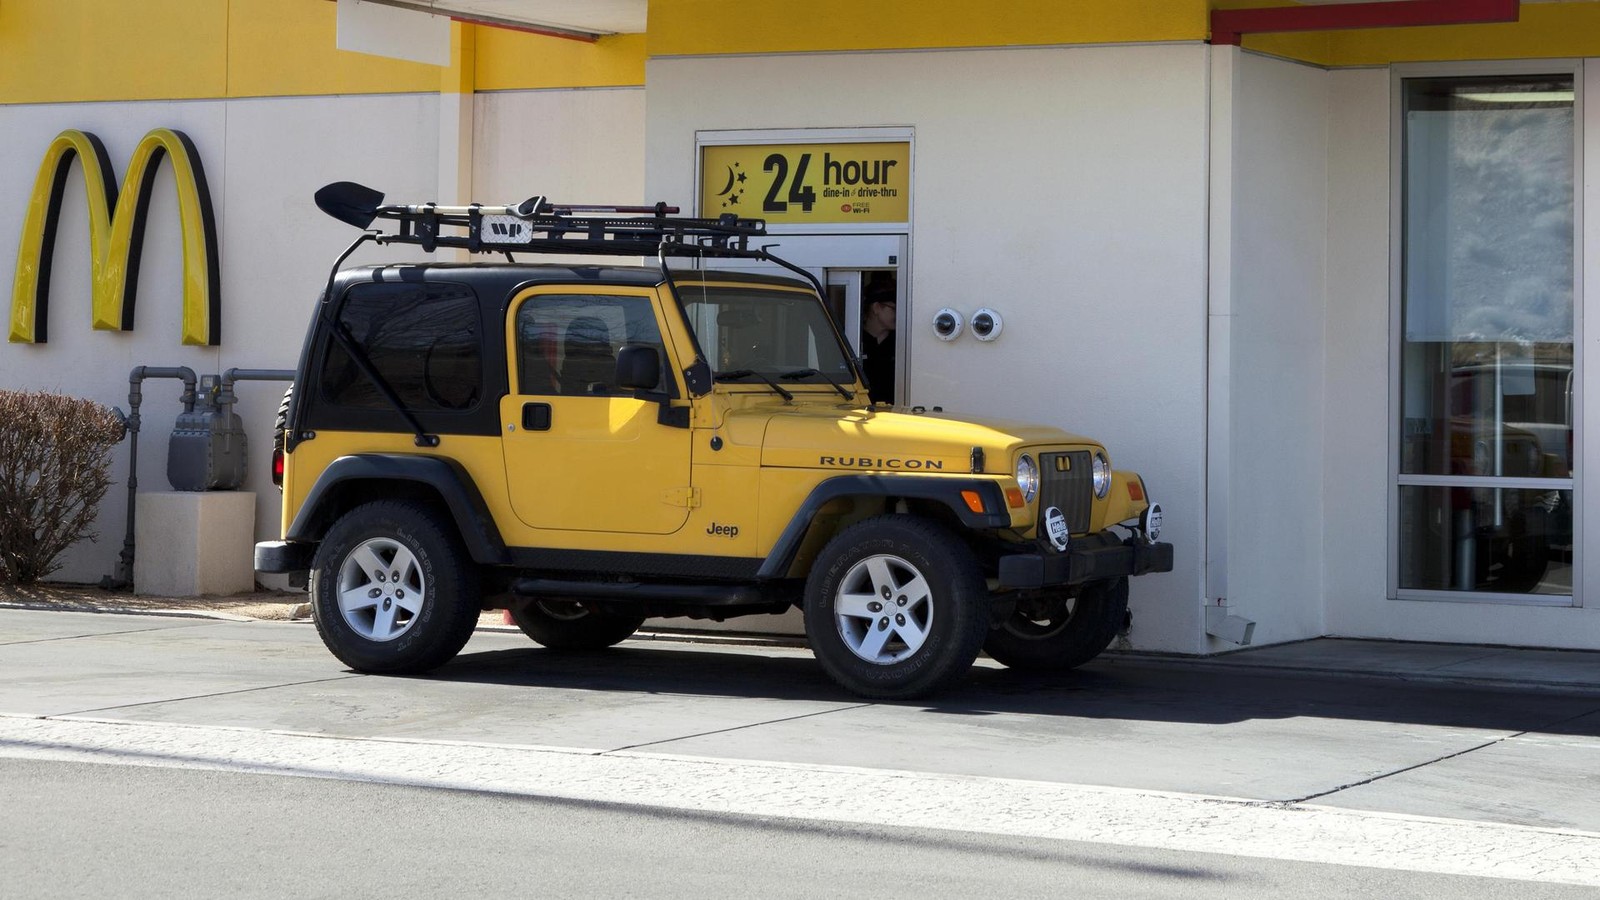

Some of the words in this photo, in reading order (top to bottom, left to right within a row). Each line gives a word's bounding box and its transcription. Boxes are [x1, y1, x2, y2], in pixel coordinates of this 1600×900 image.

[763, 153, 816, 213] 24
[823, 152, 898, 186] hour
[823, 187, 850, 198] dine-in
[858, 187, 898, 198] drive-thru
[820, 456, 943, 470] RUBICON
[706, 522, 739, 538] Jeep
